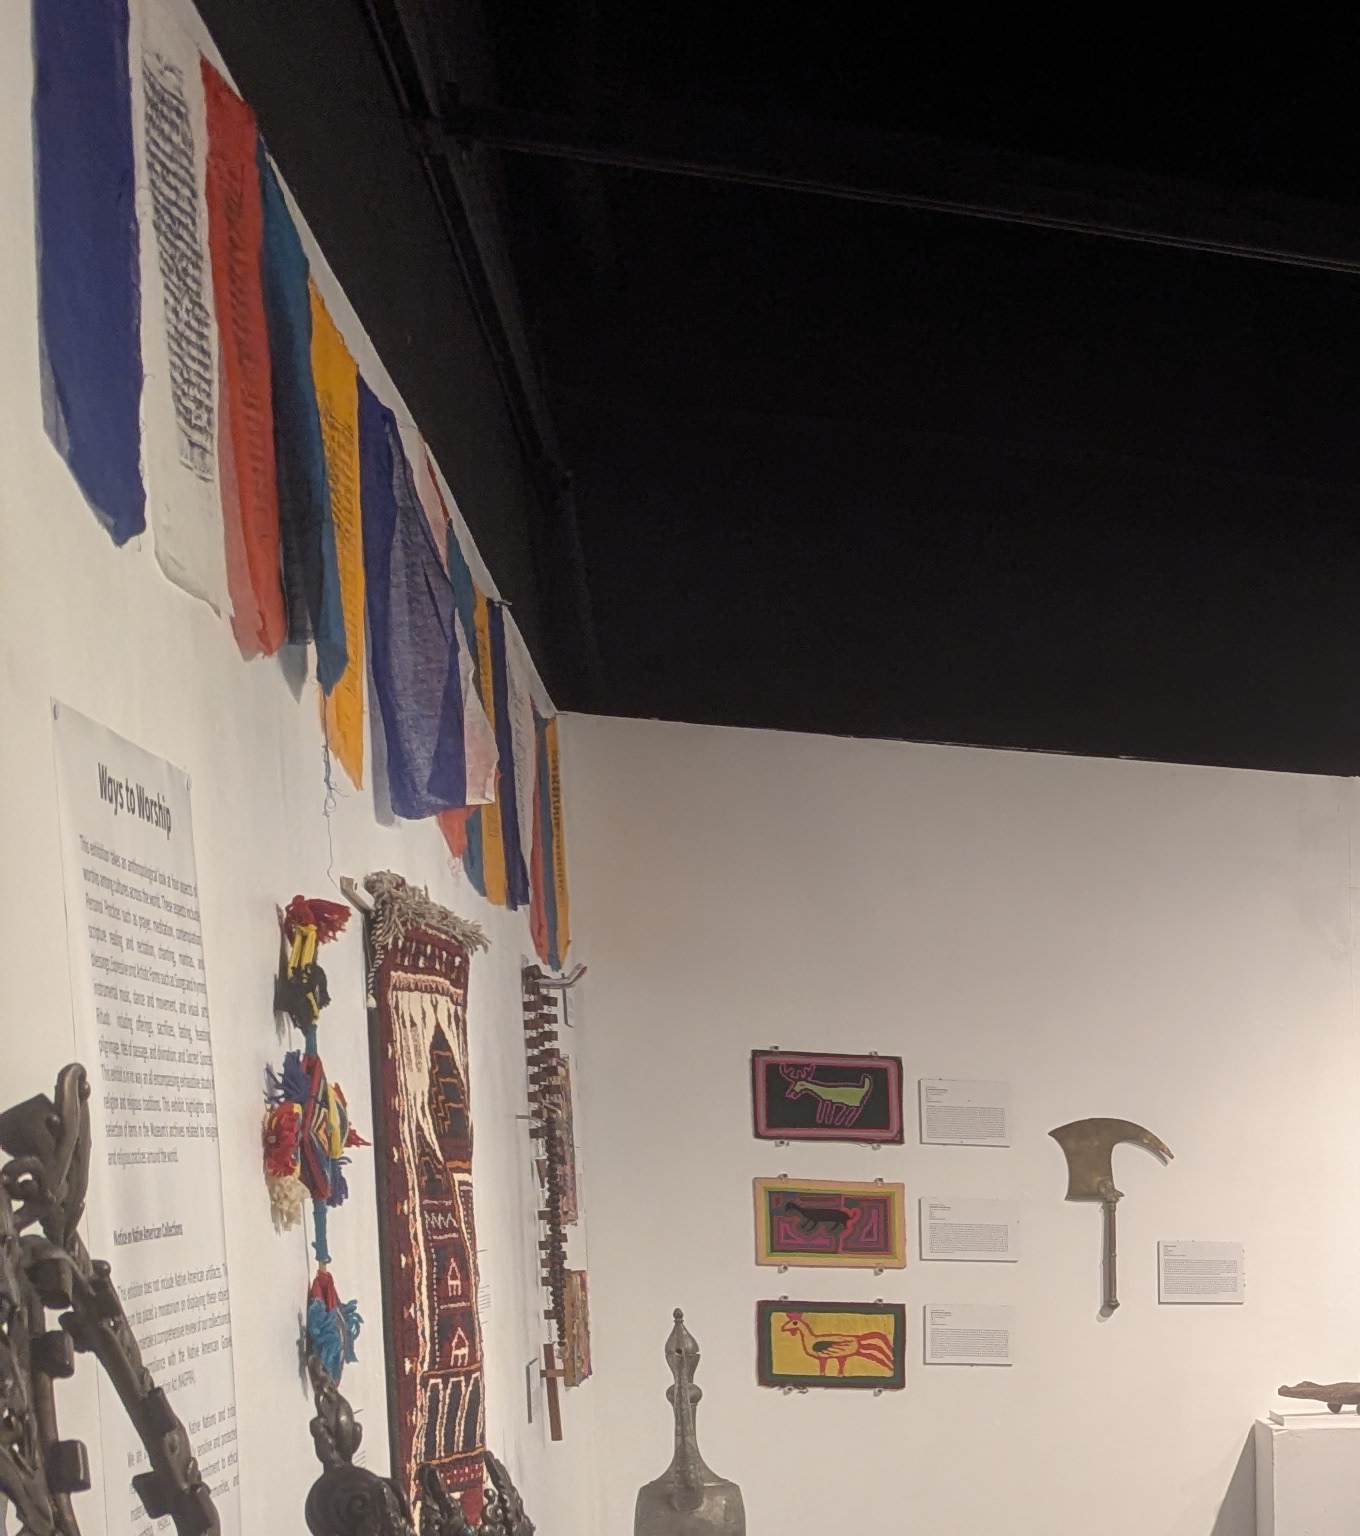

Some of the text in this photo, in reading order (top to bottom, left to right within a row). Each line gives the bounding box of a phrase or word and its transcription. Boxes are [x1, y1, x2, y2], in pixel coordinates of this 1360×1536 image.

[98, 762, 171, 840] Ways to Worship
[144, 1224, 162, 1240] American
[162, 1220, 183, 1238] Collections
